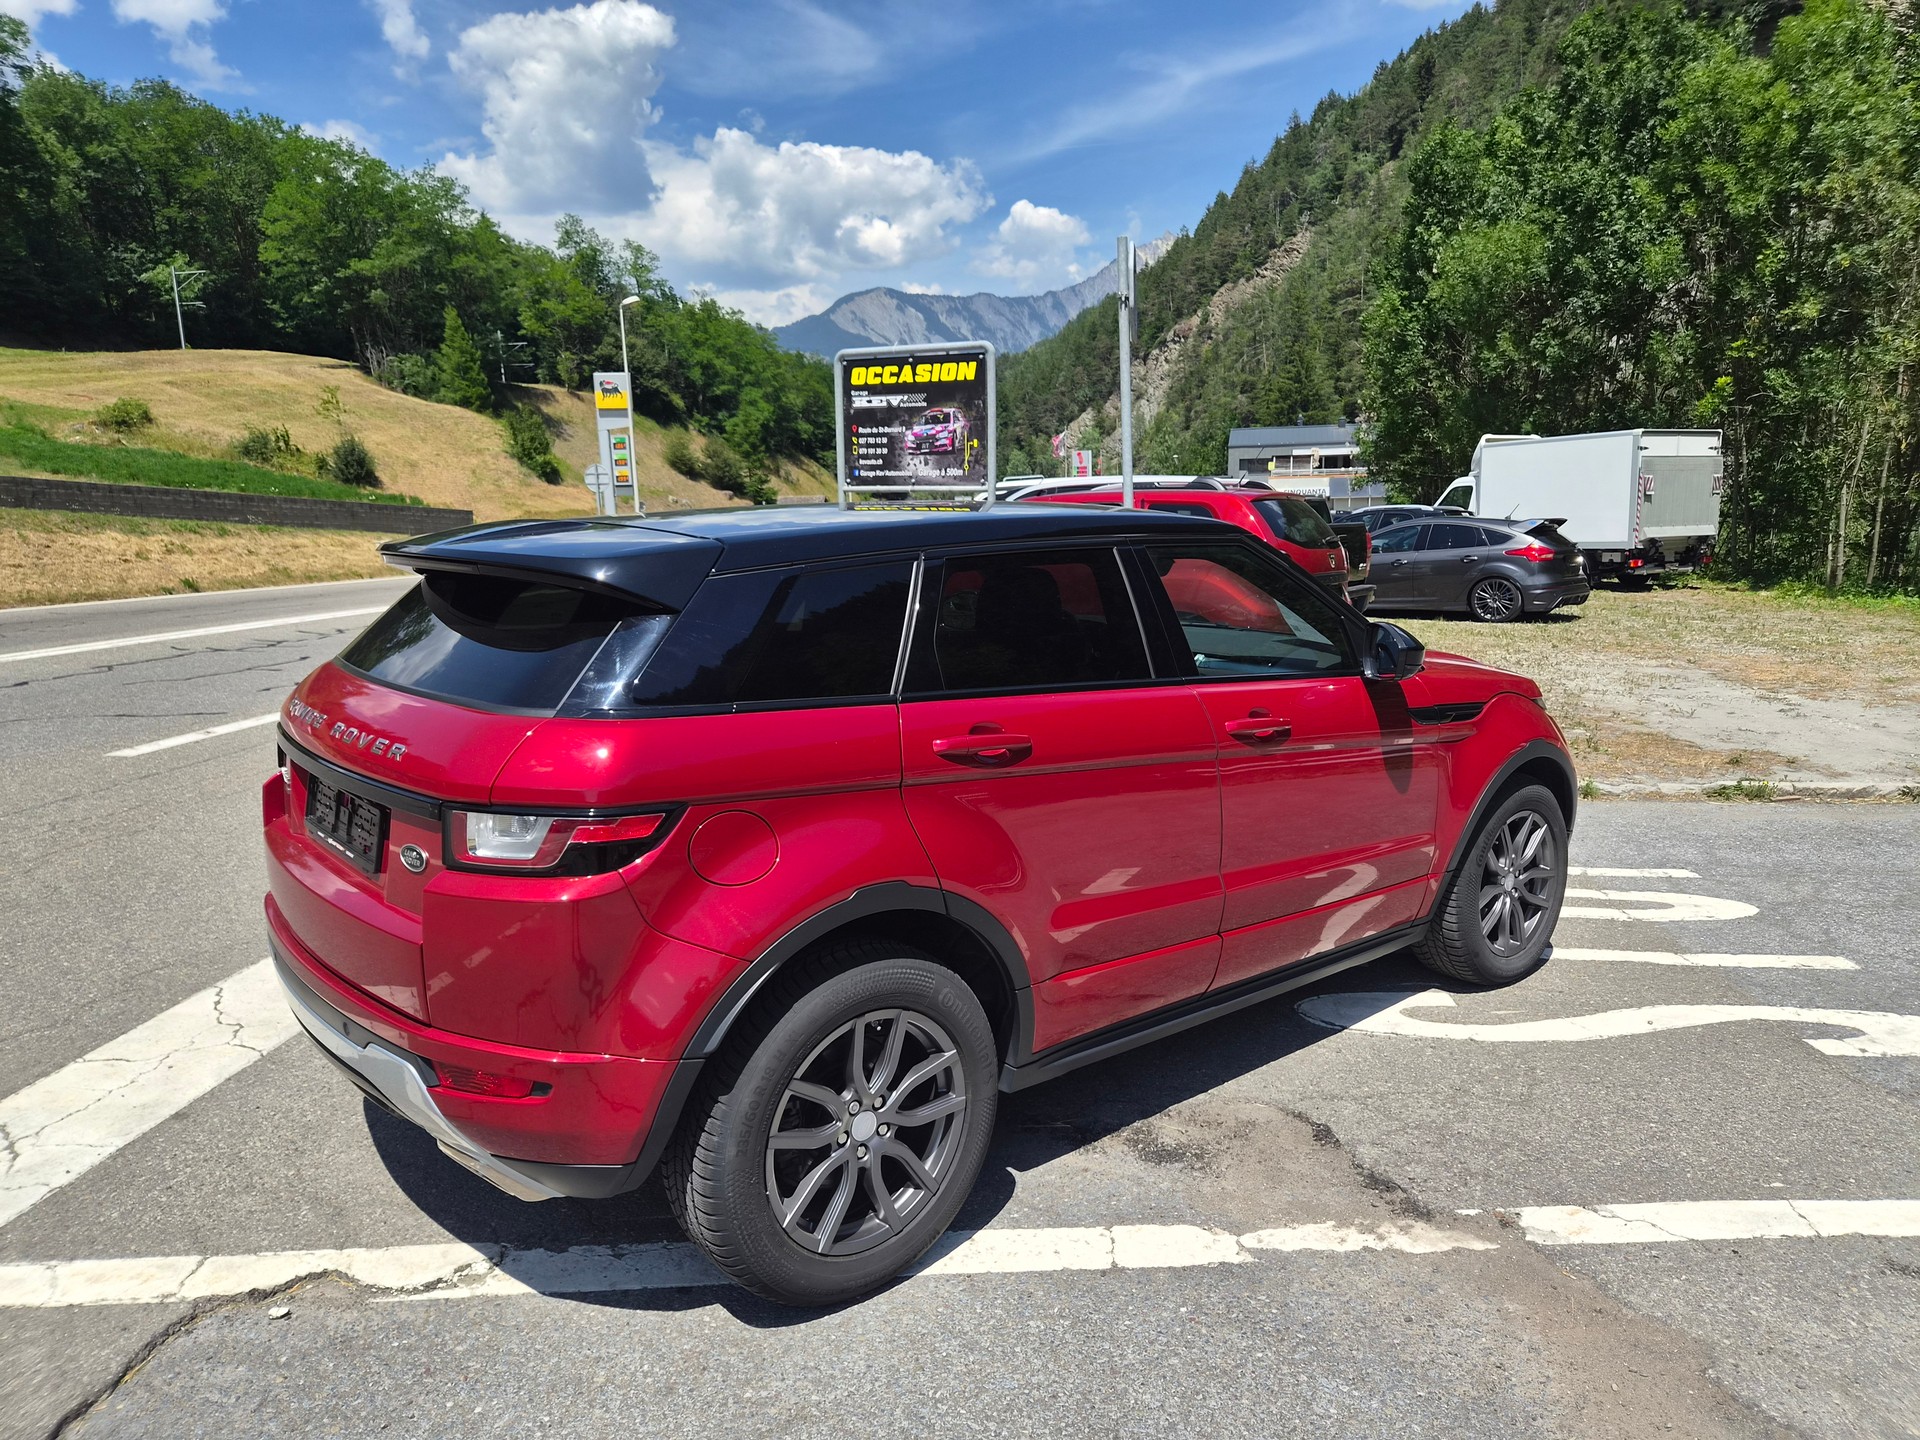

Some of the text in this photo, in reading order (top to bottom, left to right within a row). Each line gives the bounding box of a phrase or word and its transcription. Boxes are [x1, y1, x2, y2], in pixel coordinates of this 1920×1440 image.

[850, 361, 977, 386] OCCASION
[860, 470, 876, 478] Garage
[918, 468, 940, 478] Garage
[946, 467, 964, 476] 500m
[289, 697, 407, 762] RANGE ROVER
